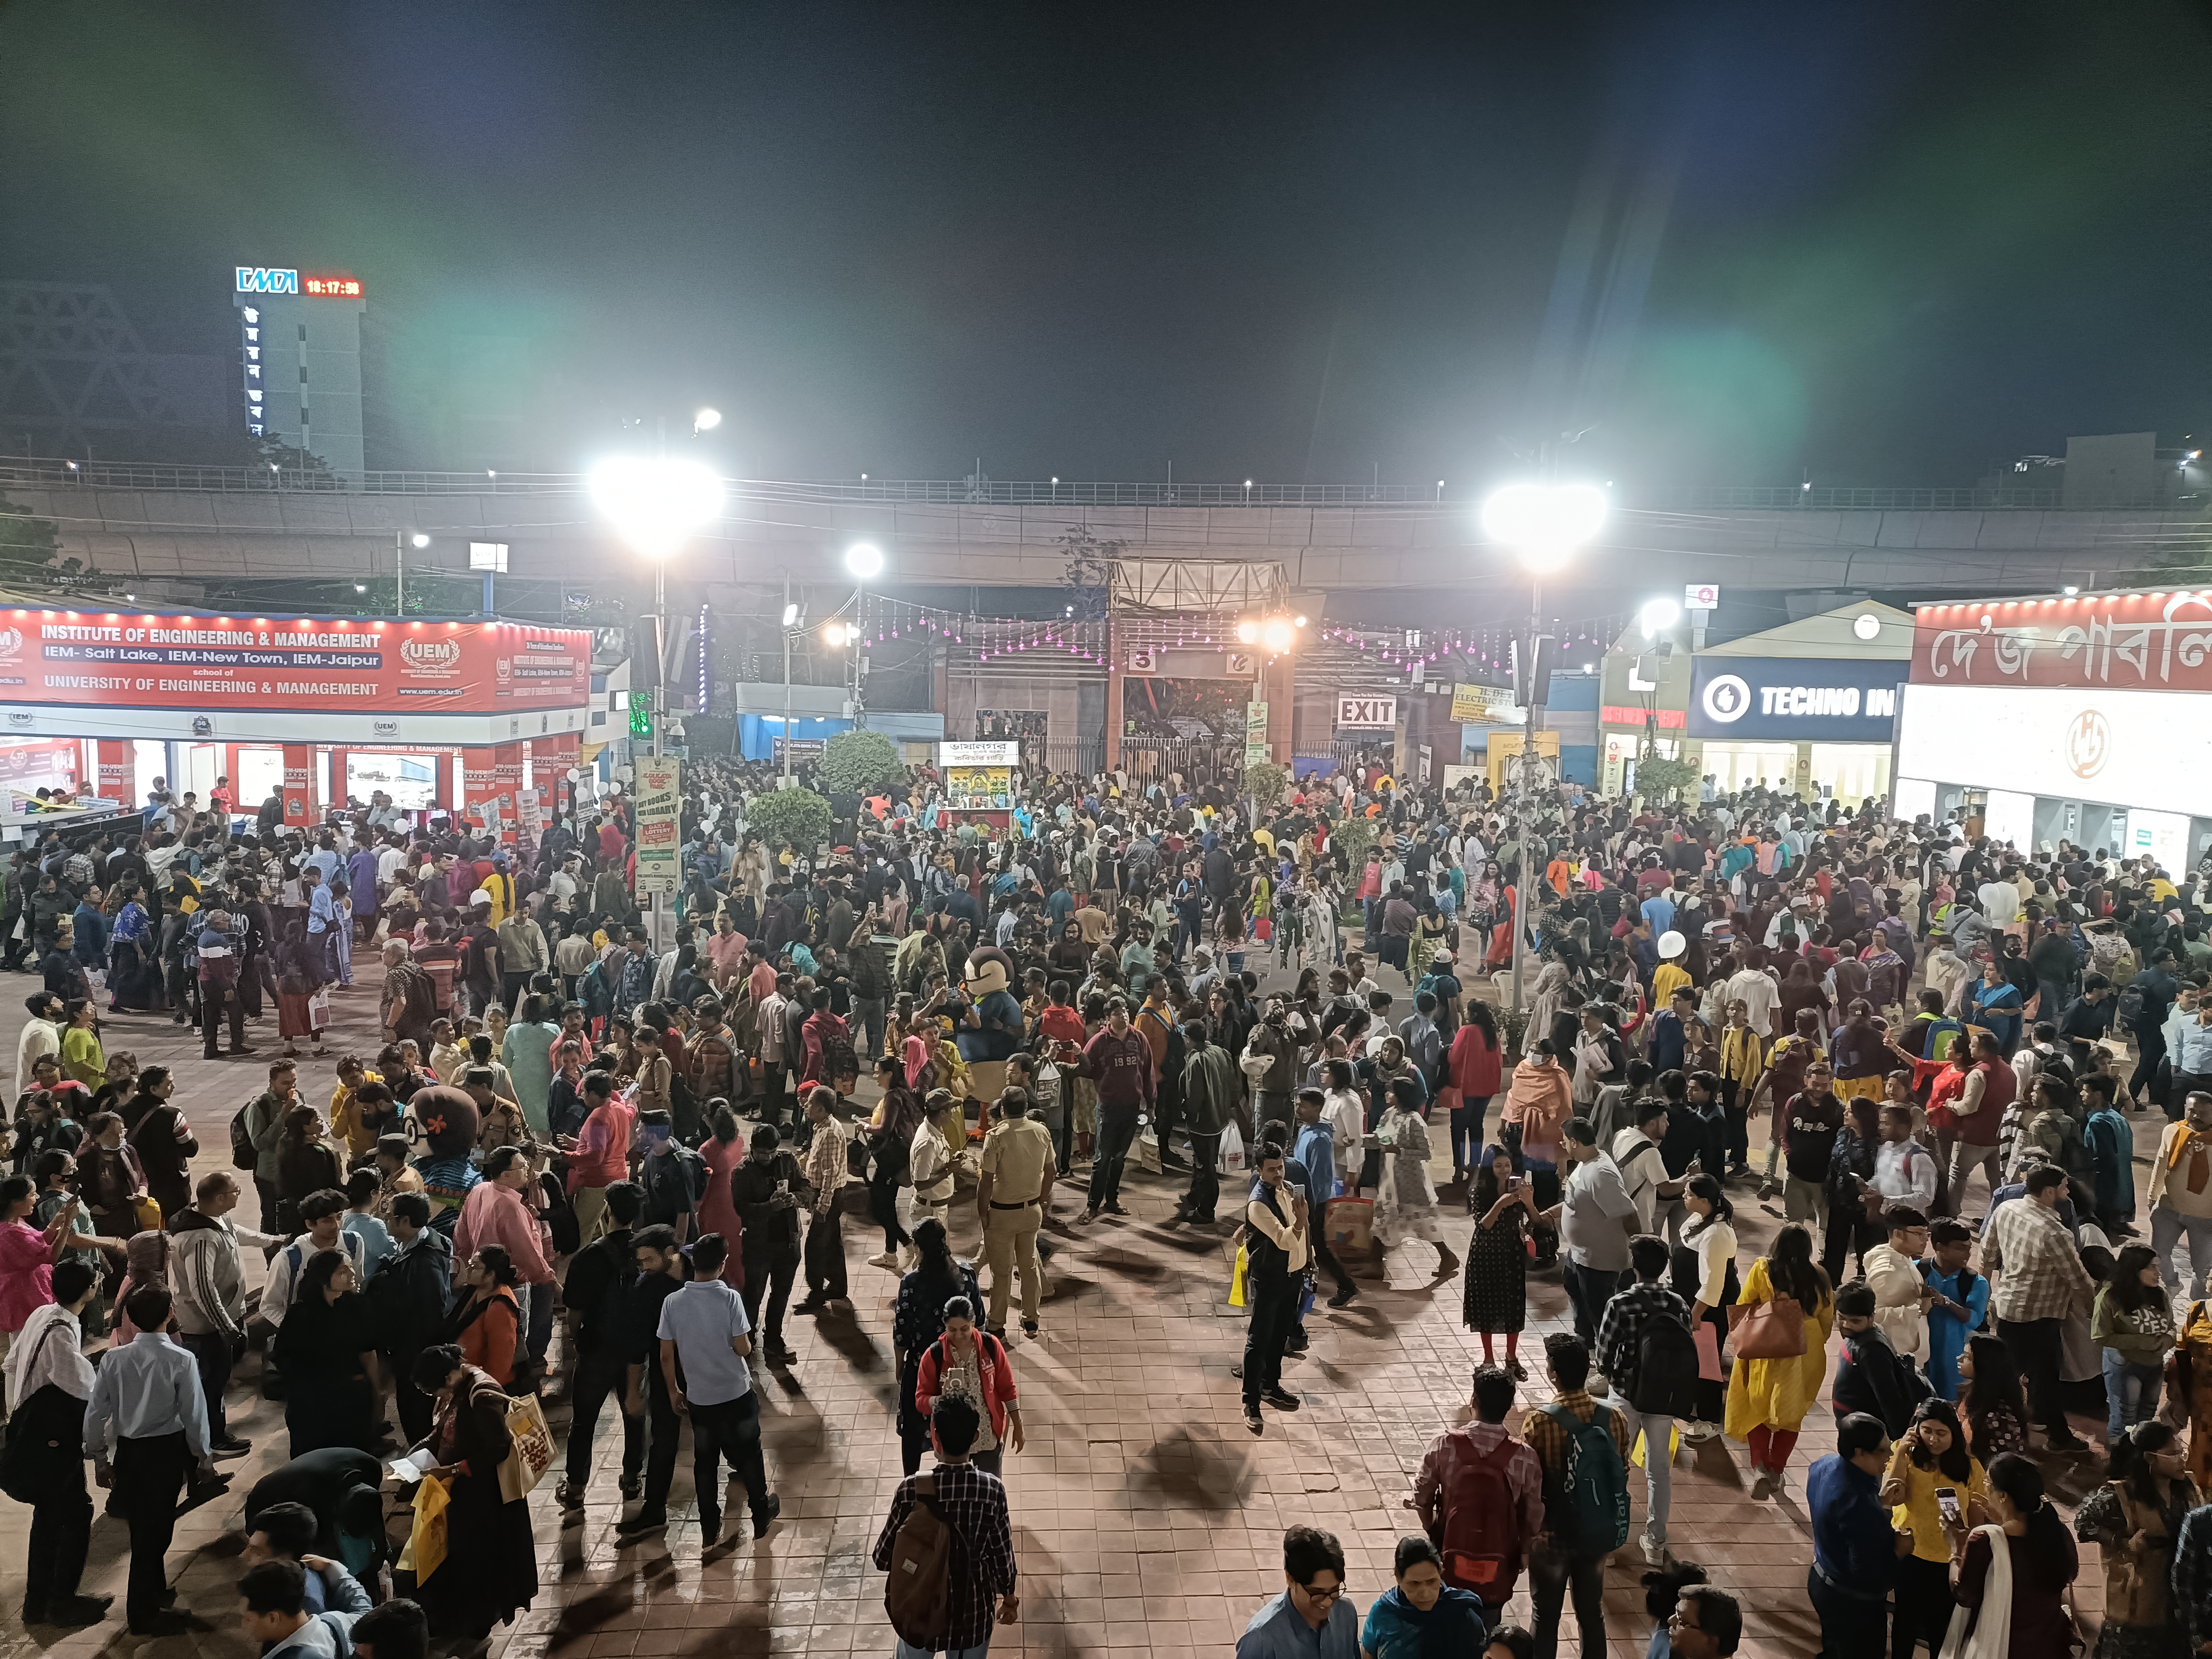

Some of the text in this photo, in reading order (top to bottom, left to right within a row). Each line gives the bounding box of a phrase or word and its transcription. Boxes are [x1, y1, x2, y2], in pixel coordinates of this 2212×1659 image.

[42, 625, 381, 648] INSTITUTE OF ENGINEERING & MANAGEMENT
[45, 646, 379, 667] IEM- Salt Lake, IEM-New Town, IEM-Jaipur
[410, 644, 450, 658] UEM
[1136, 651, 1150, 668] 5
[44, 675, 379, 695] UNIVERSITY OF ENGINEERING & MANAGEMENT
[1455, 694, 1497, 705] ELECTRIC
[1760, 686, 1896, 716] TECHNO IN
[1342, 701, 1393, 721] EXIT
[647, 792, 671, 806] BOOKS
[647, 804, 676, 815] LIBRARY
[526, 1444, 548, 1466] BOOK
[1615, 1492, 1627, 1547] safari
